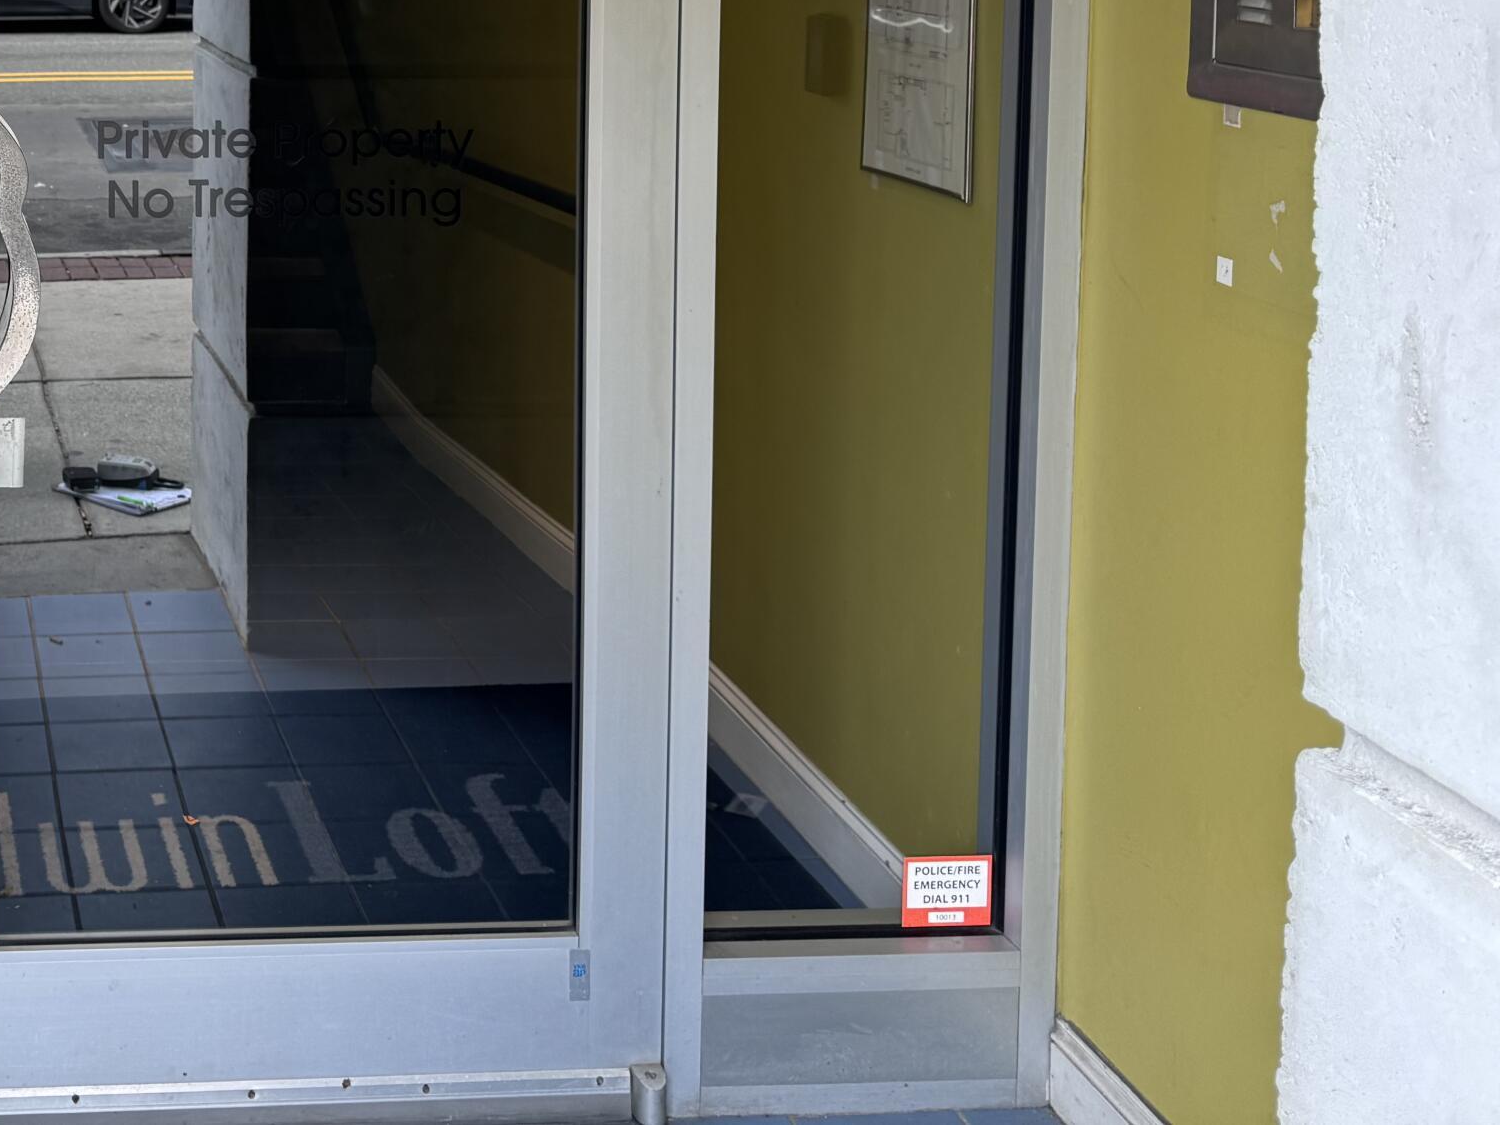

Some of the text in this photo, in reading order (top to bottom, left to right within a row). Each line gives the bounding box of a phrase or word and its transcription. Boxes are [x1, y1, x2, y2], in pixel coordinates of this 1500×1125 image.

[97, 119, 474, 166] Private Property
[108, 178, 463, 226] No Trespassing
[914, 865, 981, 876] POLICE/FIRE
[913, 879, 981, 890] EMERGENCY
[923, 894, 970, 904] DIAL 911
